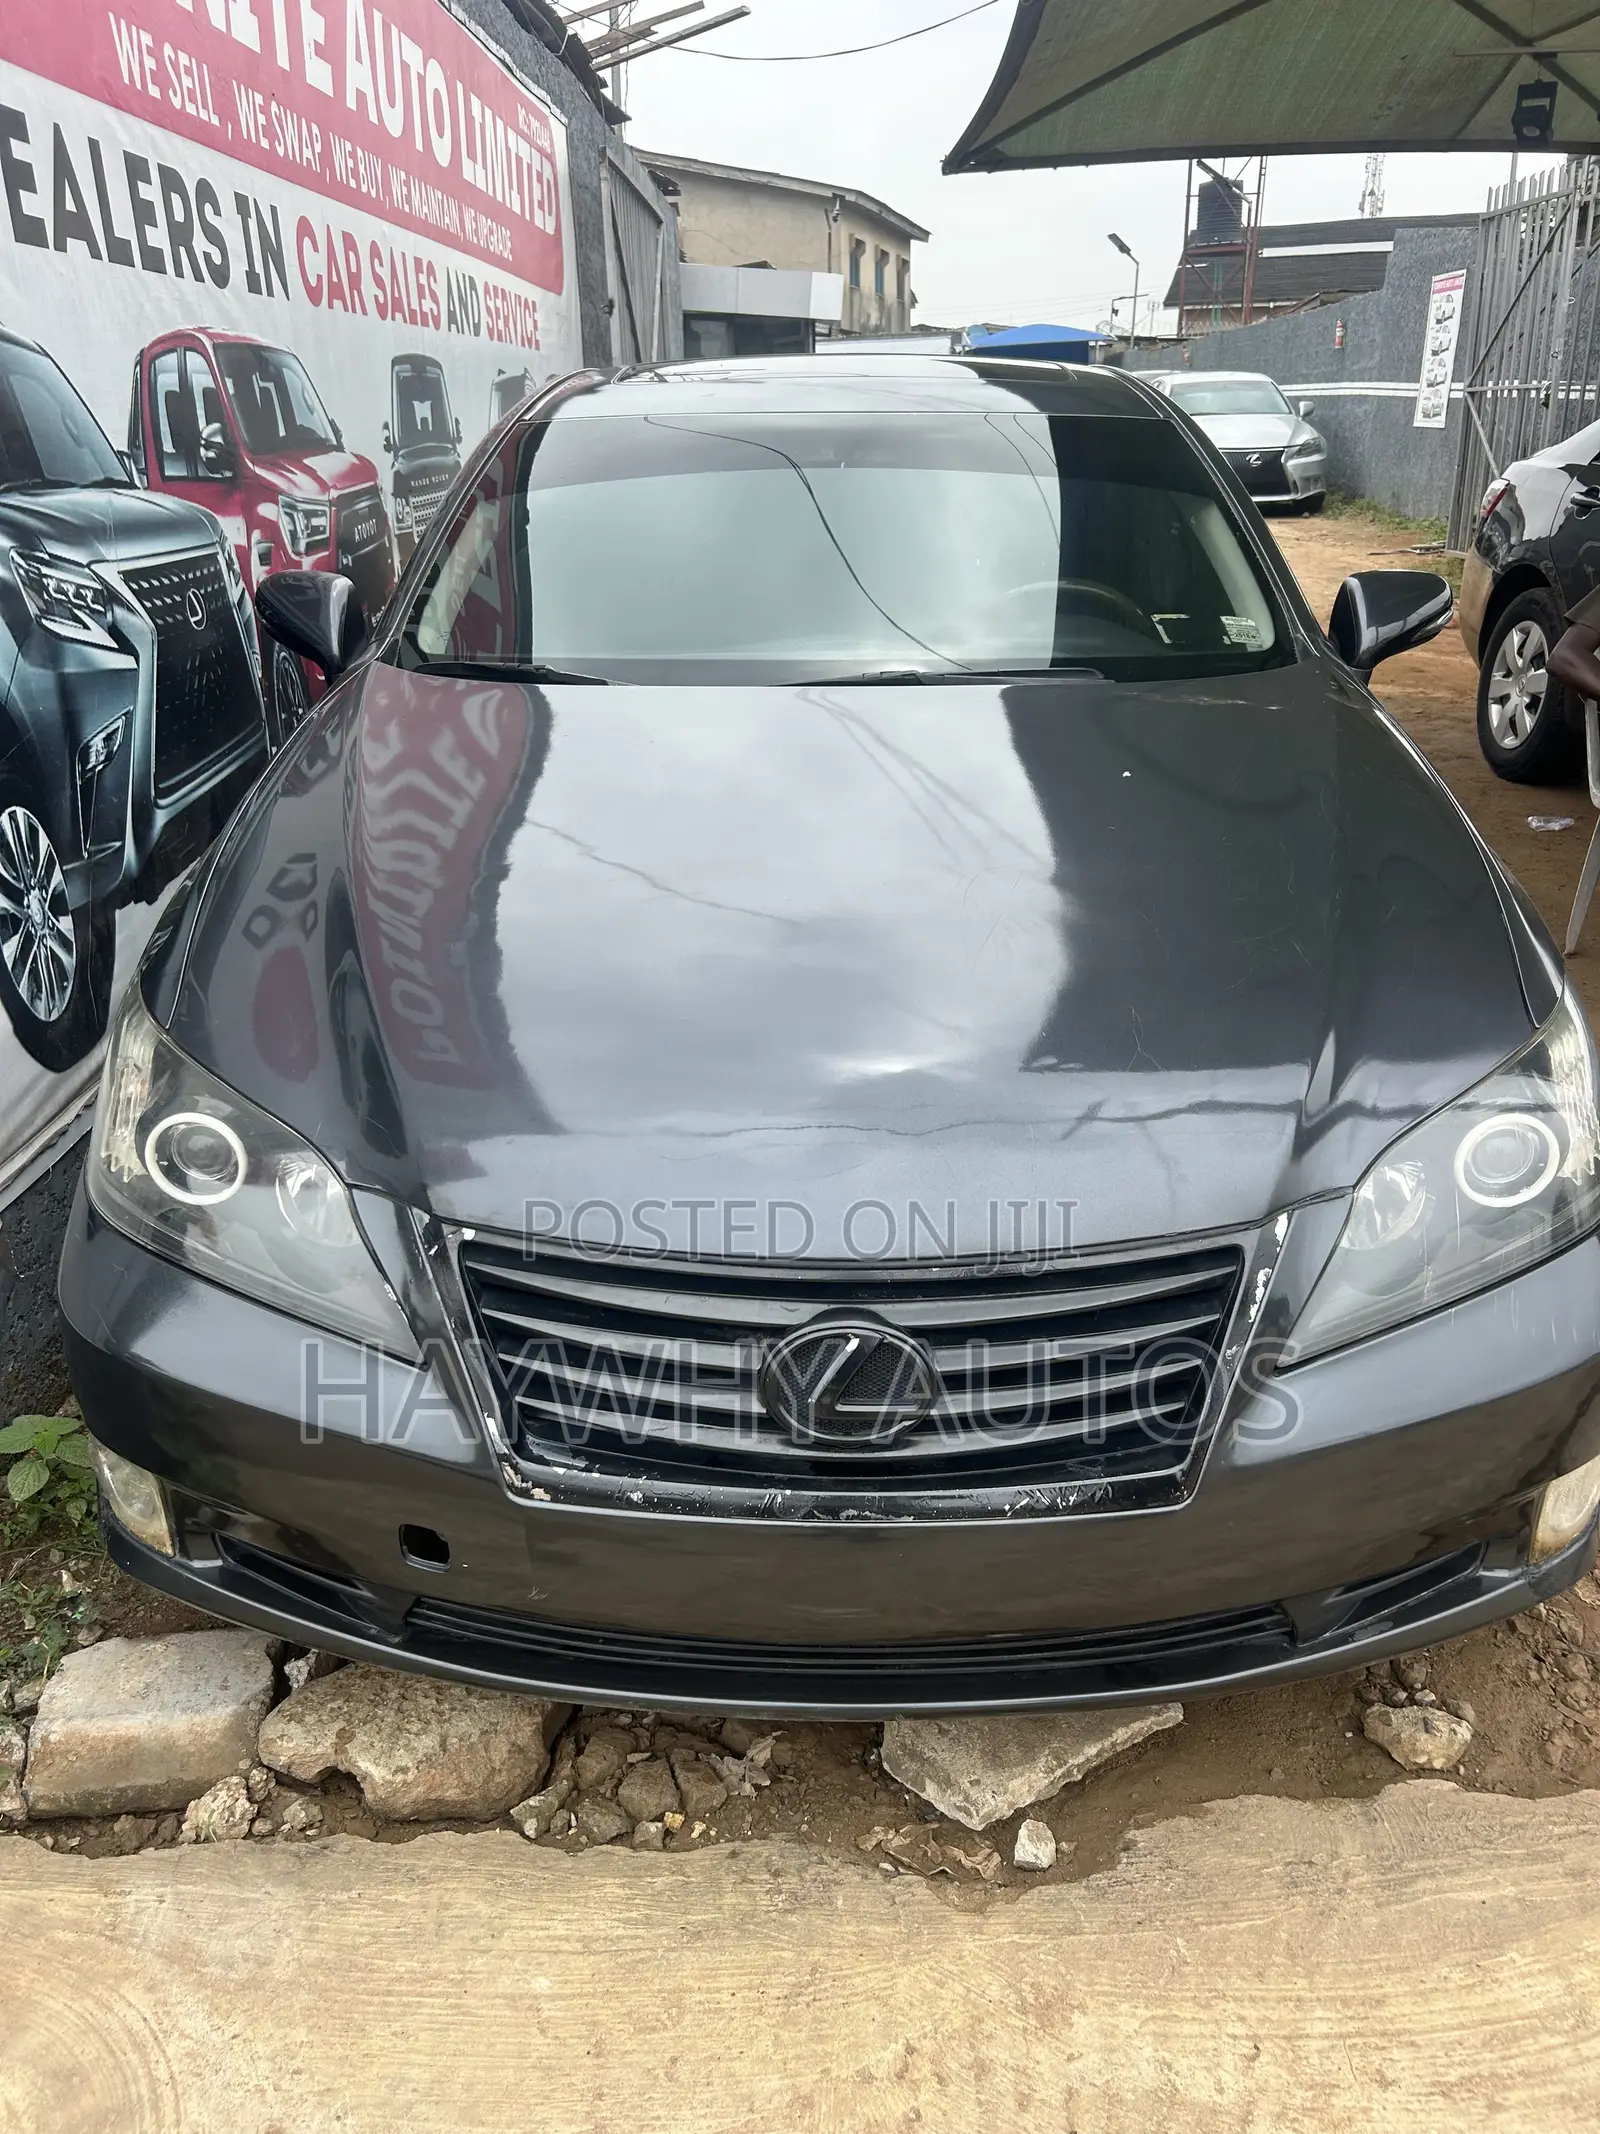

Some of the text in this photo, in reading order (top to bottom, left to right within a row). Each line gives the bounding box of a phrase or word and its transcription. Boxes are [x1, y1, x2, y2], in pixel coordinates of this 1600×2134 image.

[108, 11, 161, 100] WE
[232, 80, 270, 150] WE
[330, 132, 356, 189] WE
[388, 164, 410, 213] WE
[462, 203, 477, 245] WE
[477, 211, 512, 262] UPGRADE
[346, 0, 452, 168] AUTO
[456, 79, 557, 236] LIMITED
[233, 191, 290, 301] IN
[296, 215, 368, 316] CAR
[369, 240, 441, 331] SALES
[446, 266, 481, 337] AND
[483, 281, 541, 351] SERVICE
